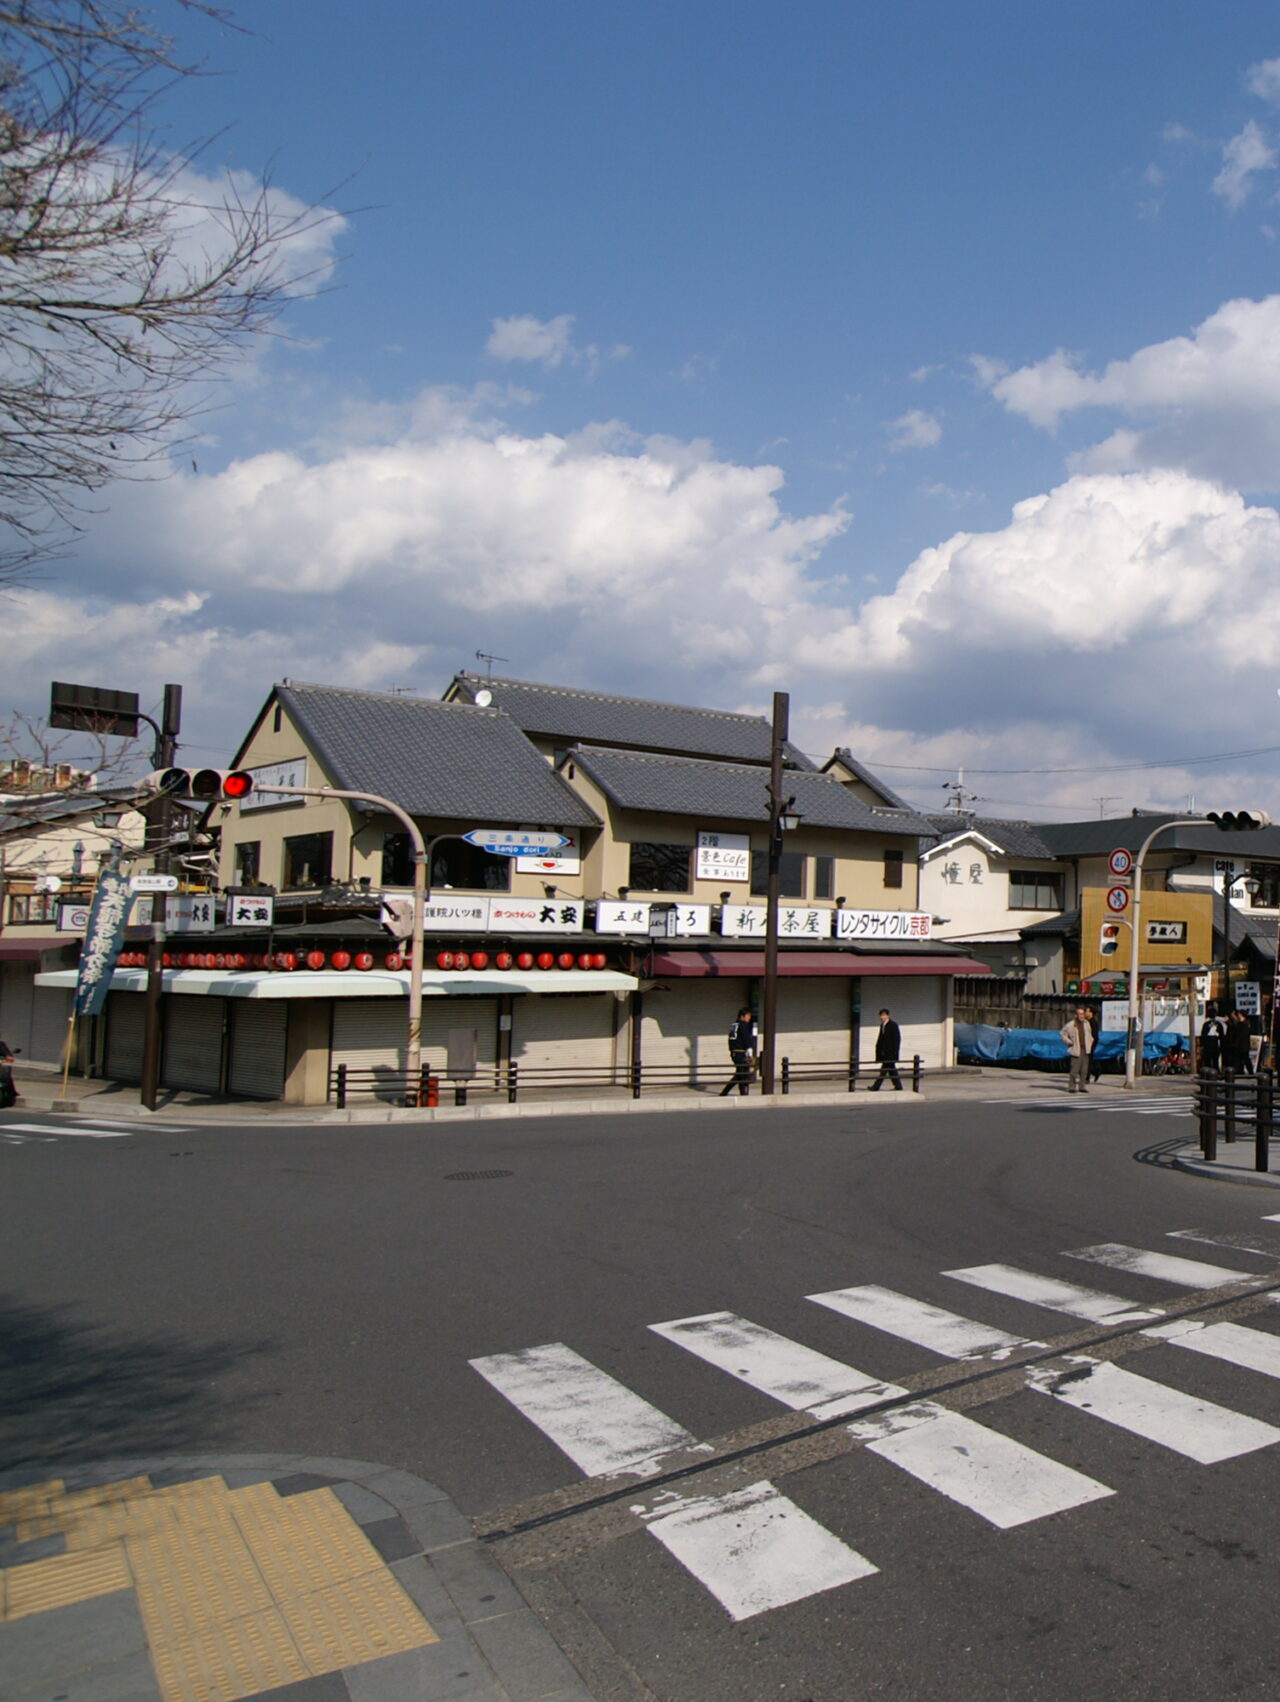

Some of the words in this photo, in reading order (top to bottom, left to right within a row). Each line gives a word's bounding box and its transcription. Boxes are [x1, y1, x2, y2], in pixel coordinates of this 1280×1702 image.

[488, 834, 545, 844] 三条通り
[1114, 856, 1126, 868] 40
[193, 904, 210, 922] 大安
[236, 907, 269, 921] 大安
[539, 905, 578, 924] 大安
[613, 909, 697, 927] 五建ろ
[841, 914, 930, 936] レンタサイクル京都
